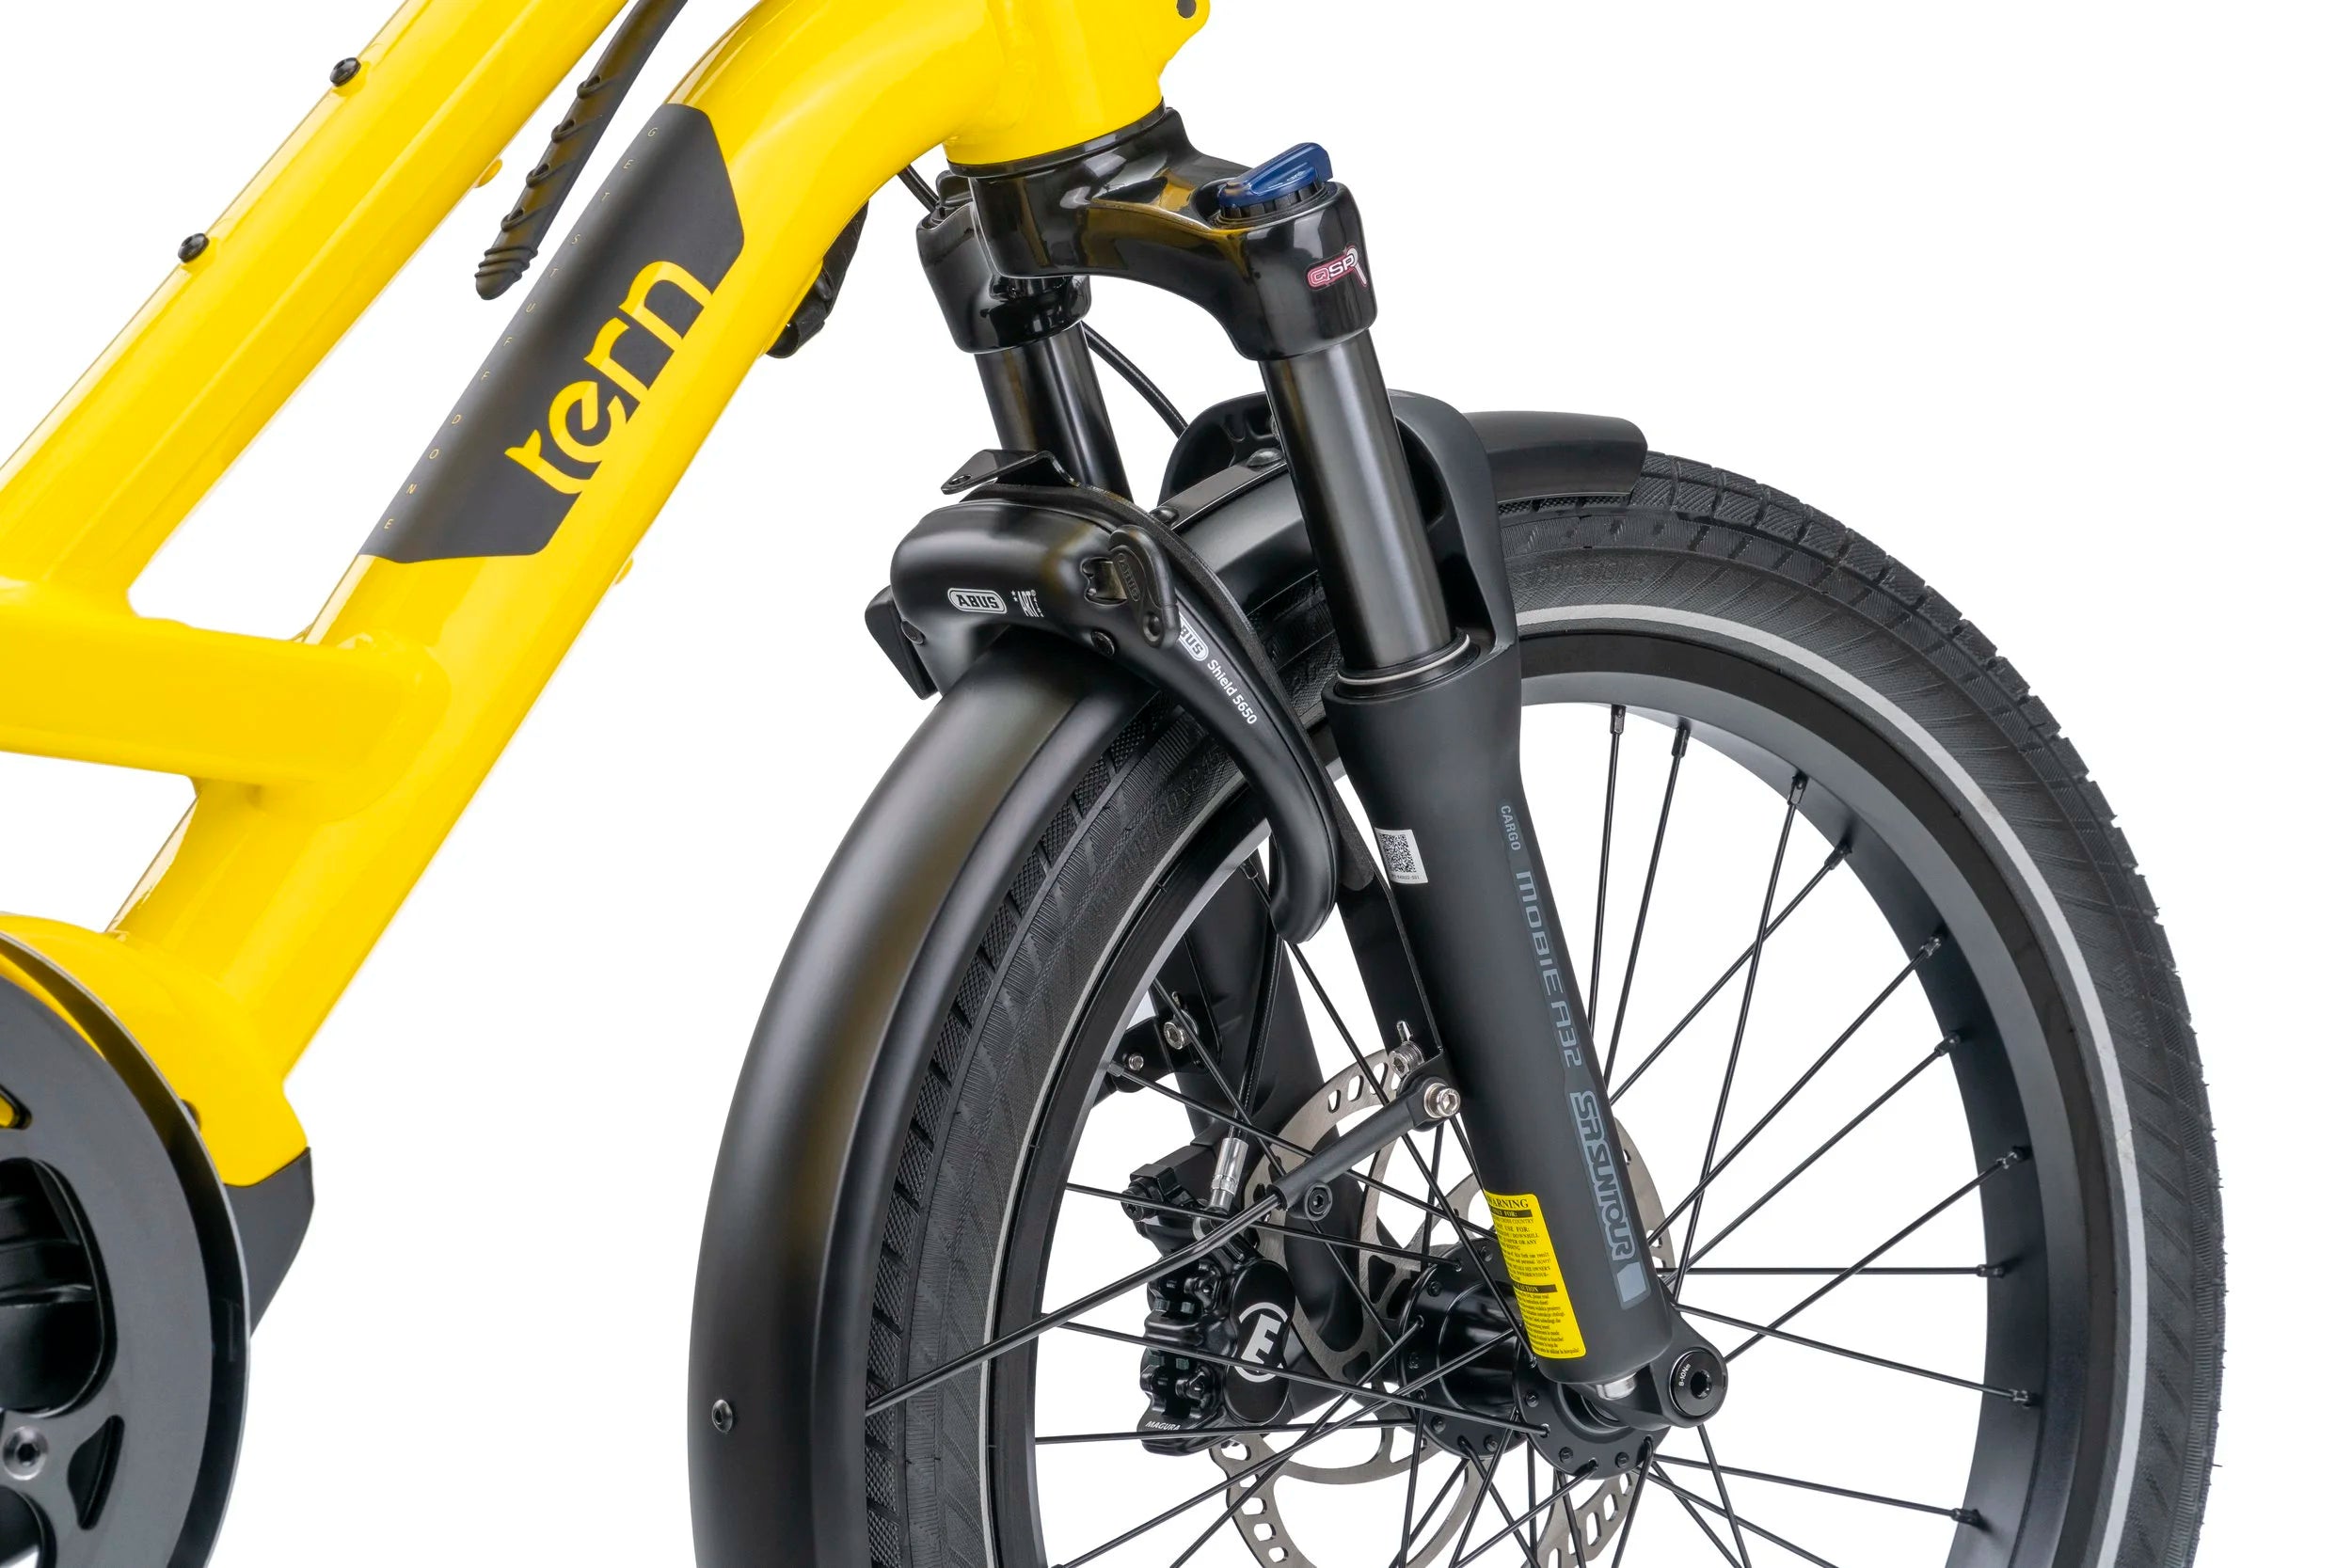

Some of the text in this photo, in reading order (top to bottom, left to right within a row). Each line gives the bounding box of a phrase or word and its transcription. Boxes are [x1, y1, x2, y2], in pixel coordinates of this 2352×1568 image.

[383, 127, 658, 530] GET STUFF DONE
[956, 594, 1000, 609] ABUS
[1207, 658, 1258, 725] Shield 5650
[1501, 804, 1521, 851] CARGO
[1516, 870, 1582, 1069] MOBIE A32
